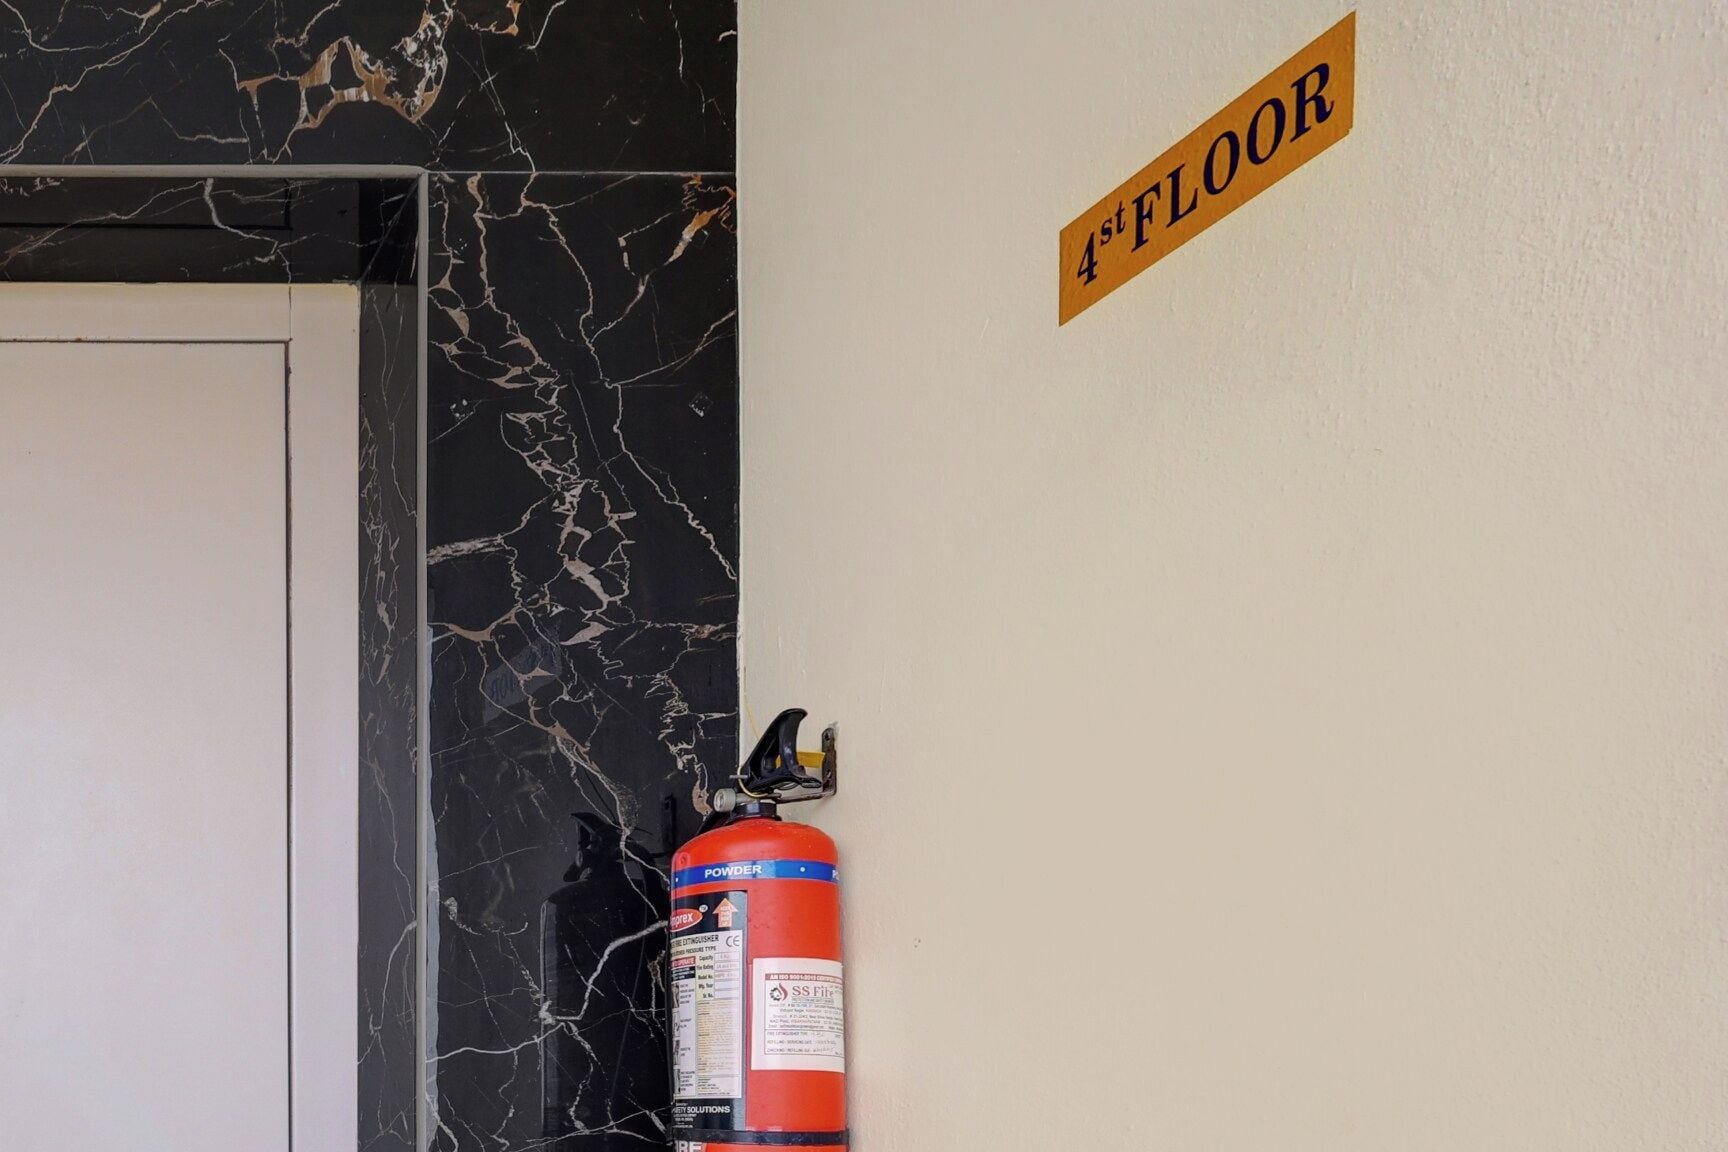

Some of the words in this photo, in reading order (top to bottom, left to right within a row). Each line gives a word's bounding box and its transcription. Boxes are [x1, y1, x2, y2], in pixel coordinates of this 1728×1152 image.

[1130, 62, 1335, 253] FLOOR
[704, 865, 762, 878] POWDER
[792, 985, 810, 997] SS
[687, 1105, 731, 1114] SOLUTIONS
